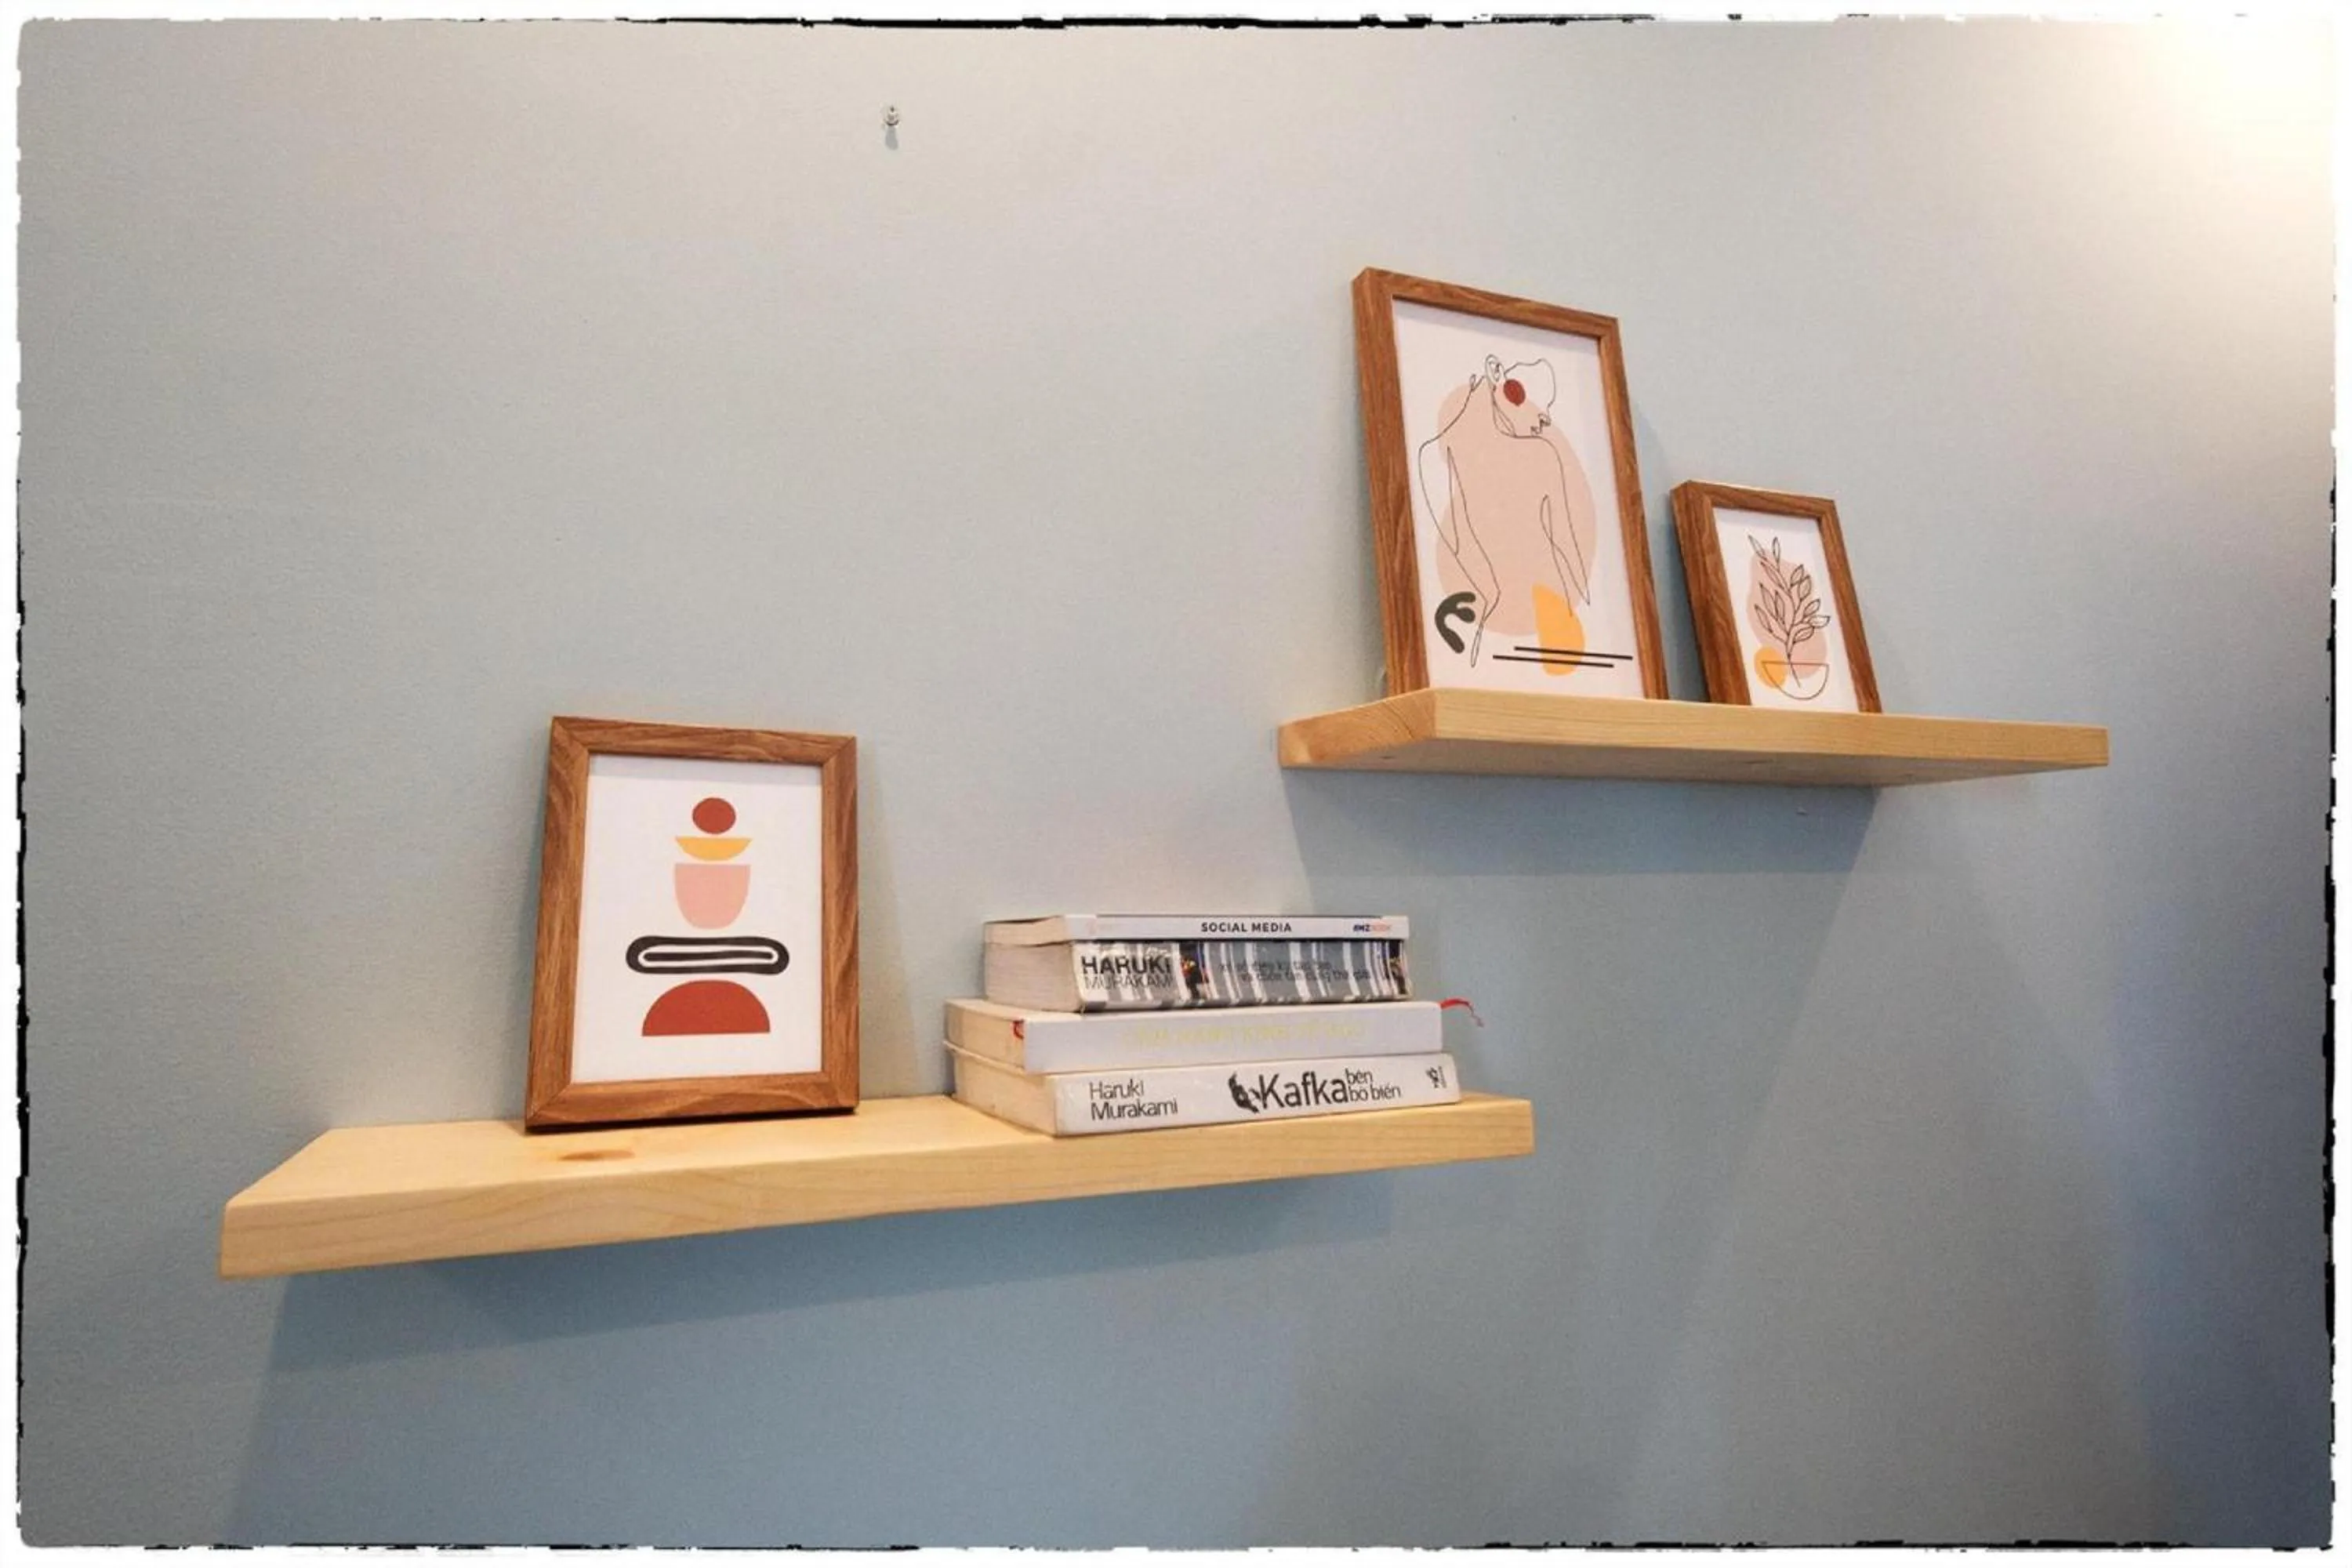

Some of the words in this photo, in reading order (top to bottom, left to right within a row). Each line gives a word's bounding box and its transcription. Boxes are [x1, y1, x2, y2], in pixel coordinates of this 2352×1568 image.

[1201, 922, 1247, 933] SOCIAL
[1251, 922, 1292, 933] MEDIA
[1080, 955, 1173, 975] HARUKI
[1083, 974, 1173, 990] MURAKAMI
[1089, 1079, 1144, 1099] Haruki
[1258, 1071, 1349, 1109] Kafka
[1091, 1098, 1178, 1120] Murakami
